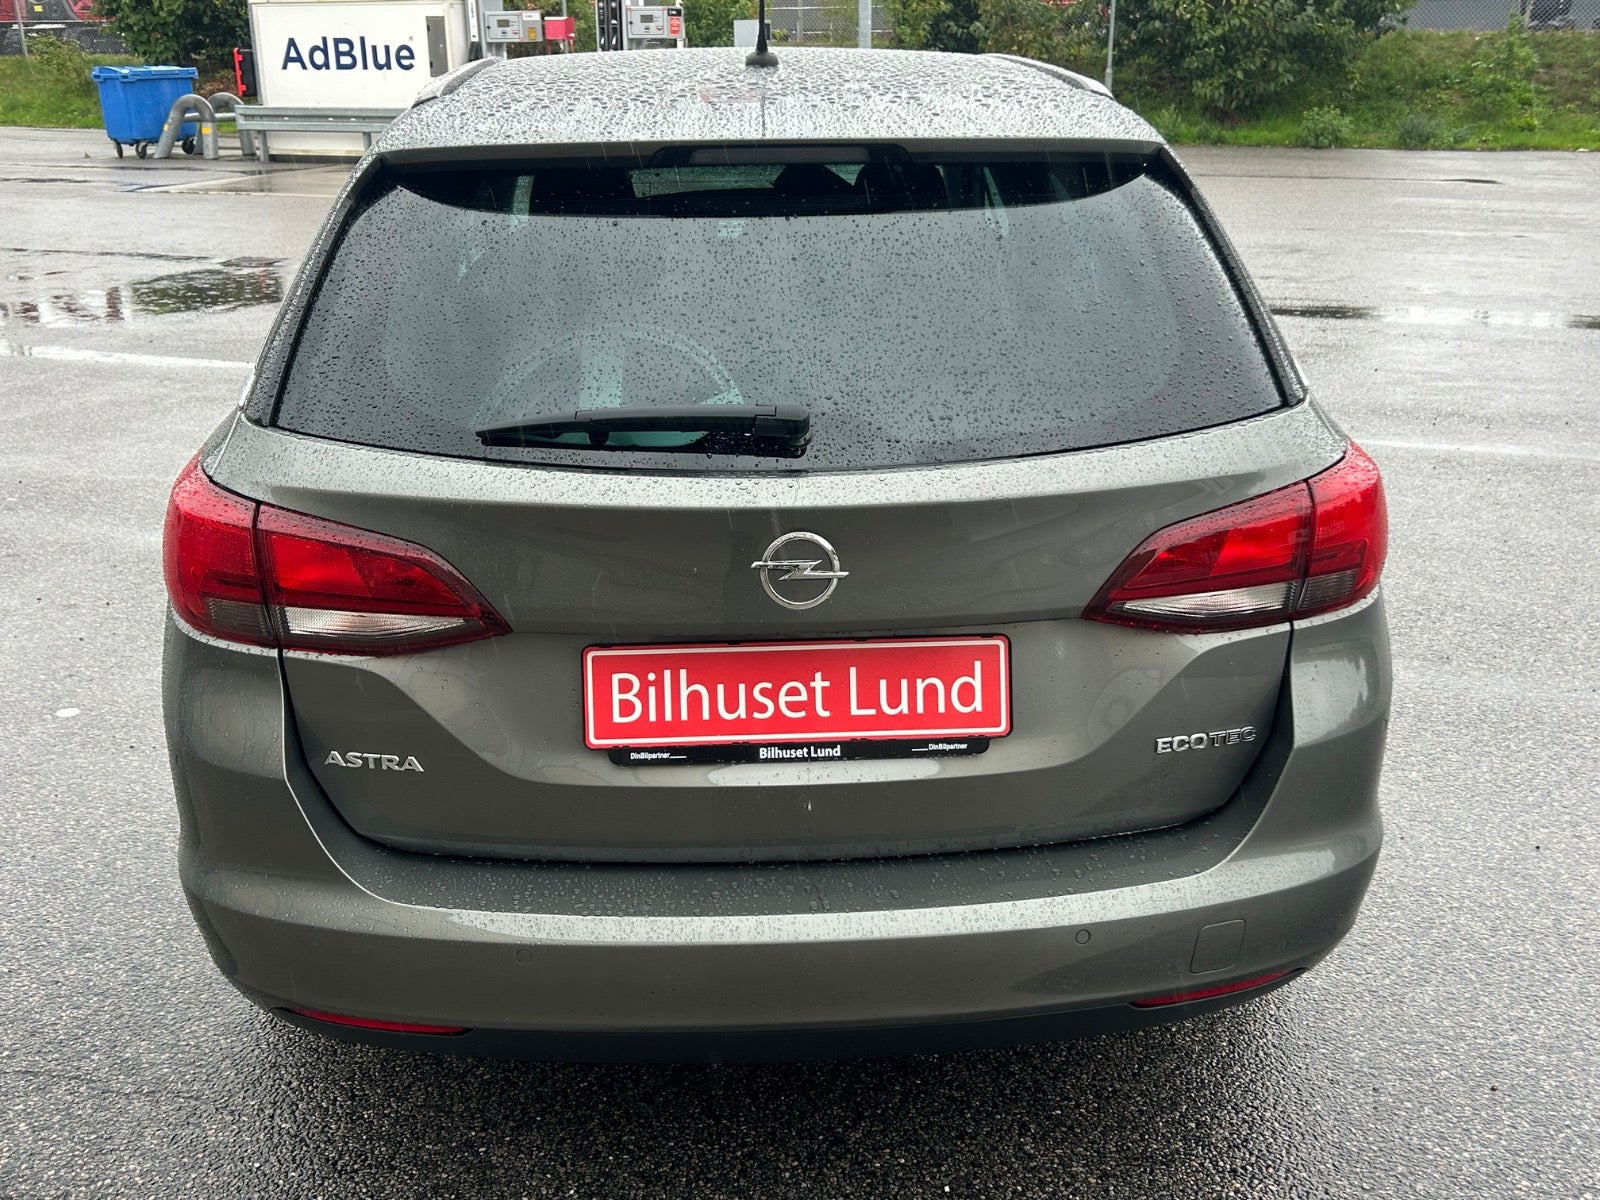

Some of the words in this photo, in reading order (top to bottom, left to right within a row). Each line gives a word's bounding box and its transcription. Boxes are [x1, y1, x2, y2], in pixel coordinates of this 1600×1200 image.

[281, 36, 416, 71] AdBlue
[611, 669, 831, 723] Bilhuset
[849, 660, 984, 717] Lund
[759, 747, 809, 759] Bilhuset
[810, 745, 841, 757] Lund
[1155, 726, 1256, 754] ECOTEC
[324, 750, 425, 772] ASTRA
